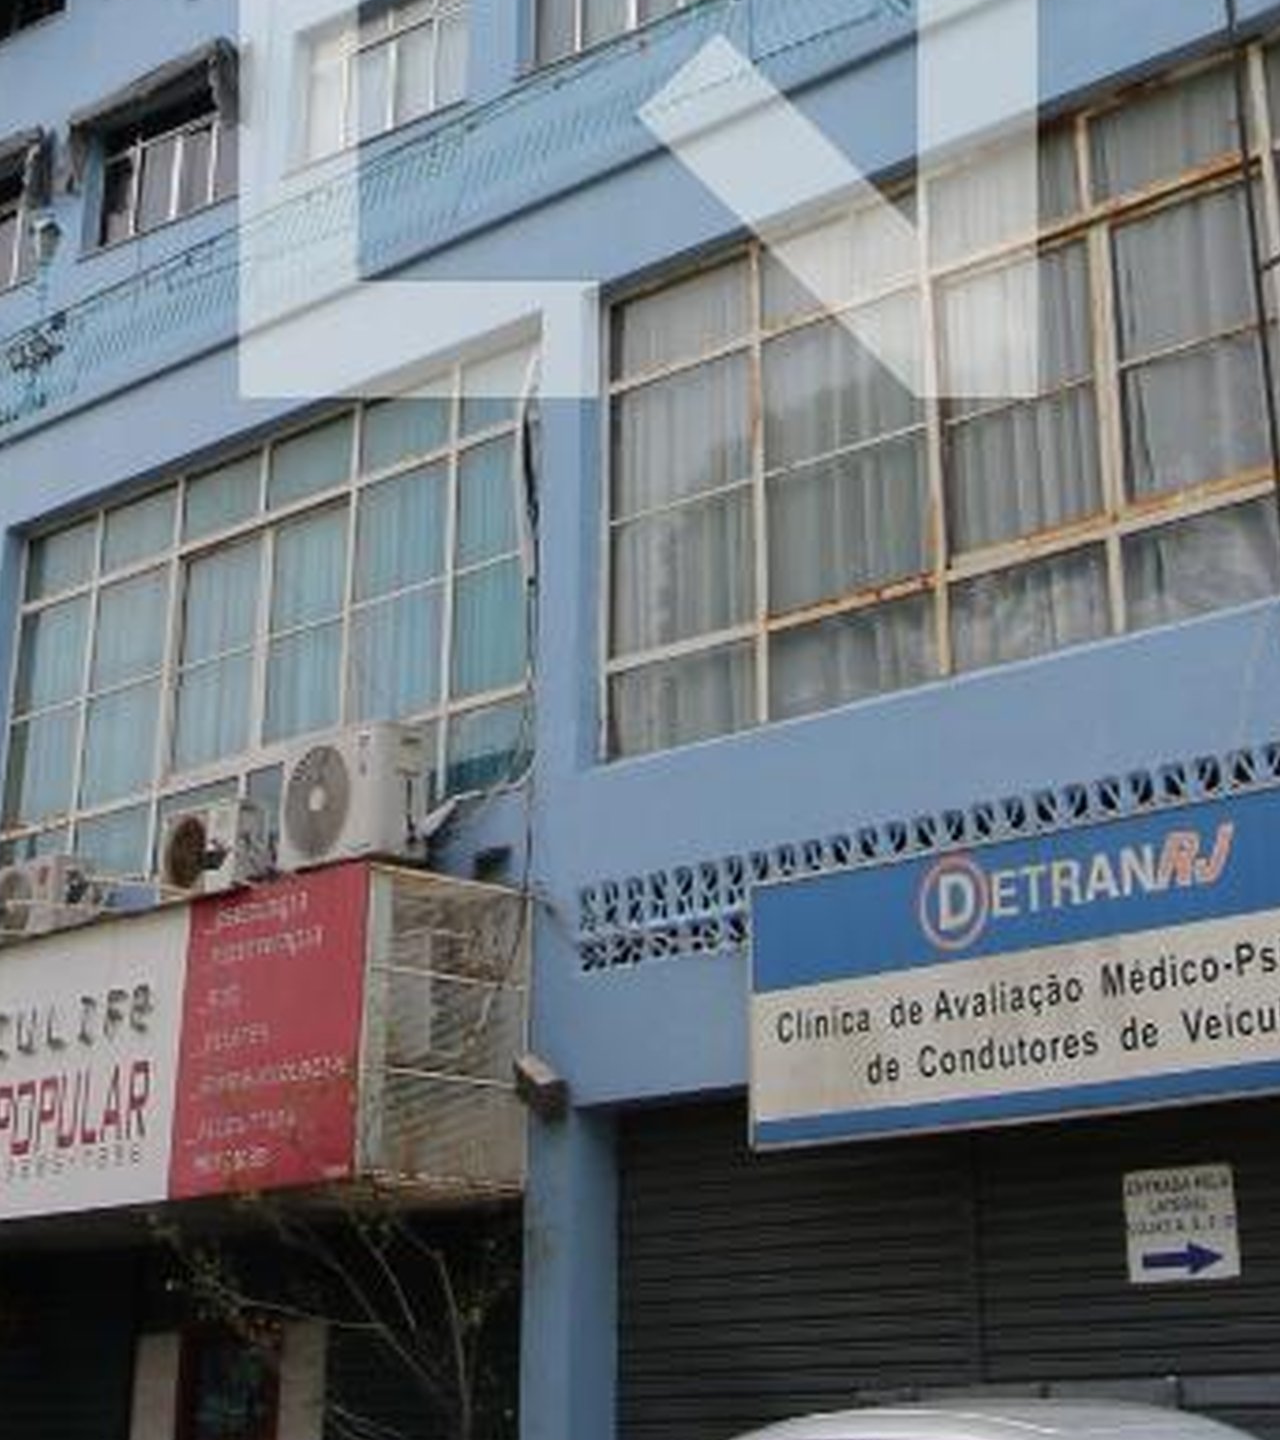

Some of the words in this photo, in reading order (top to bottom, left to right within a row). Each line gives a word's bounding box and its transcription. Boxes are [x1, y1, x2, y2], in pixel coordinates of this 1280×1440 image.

[888, 995, 924, 1028] de
[934, 972, 1083, 1022] Avaliação
[867, 1054, 900, 1085] de
[919, 1028, 1099, 1078] Condutores
[1120, 1017, 1160, 1052] de
